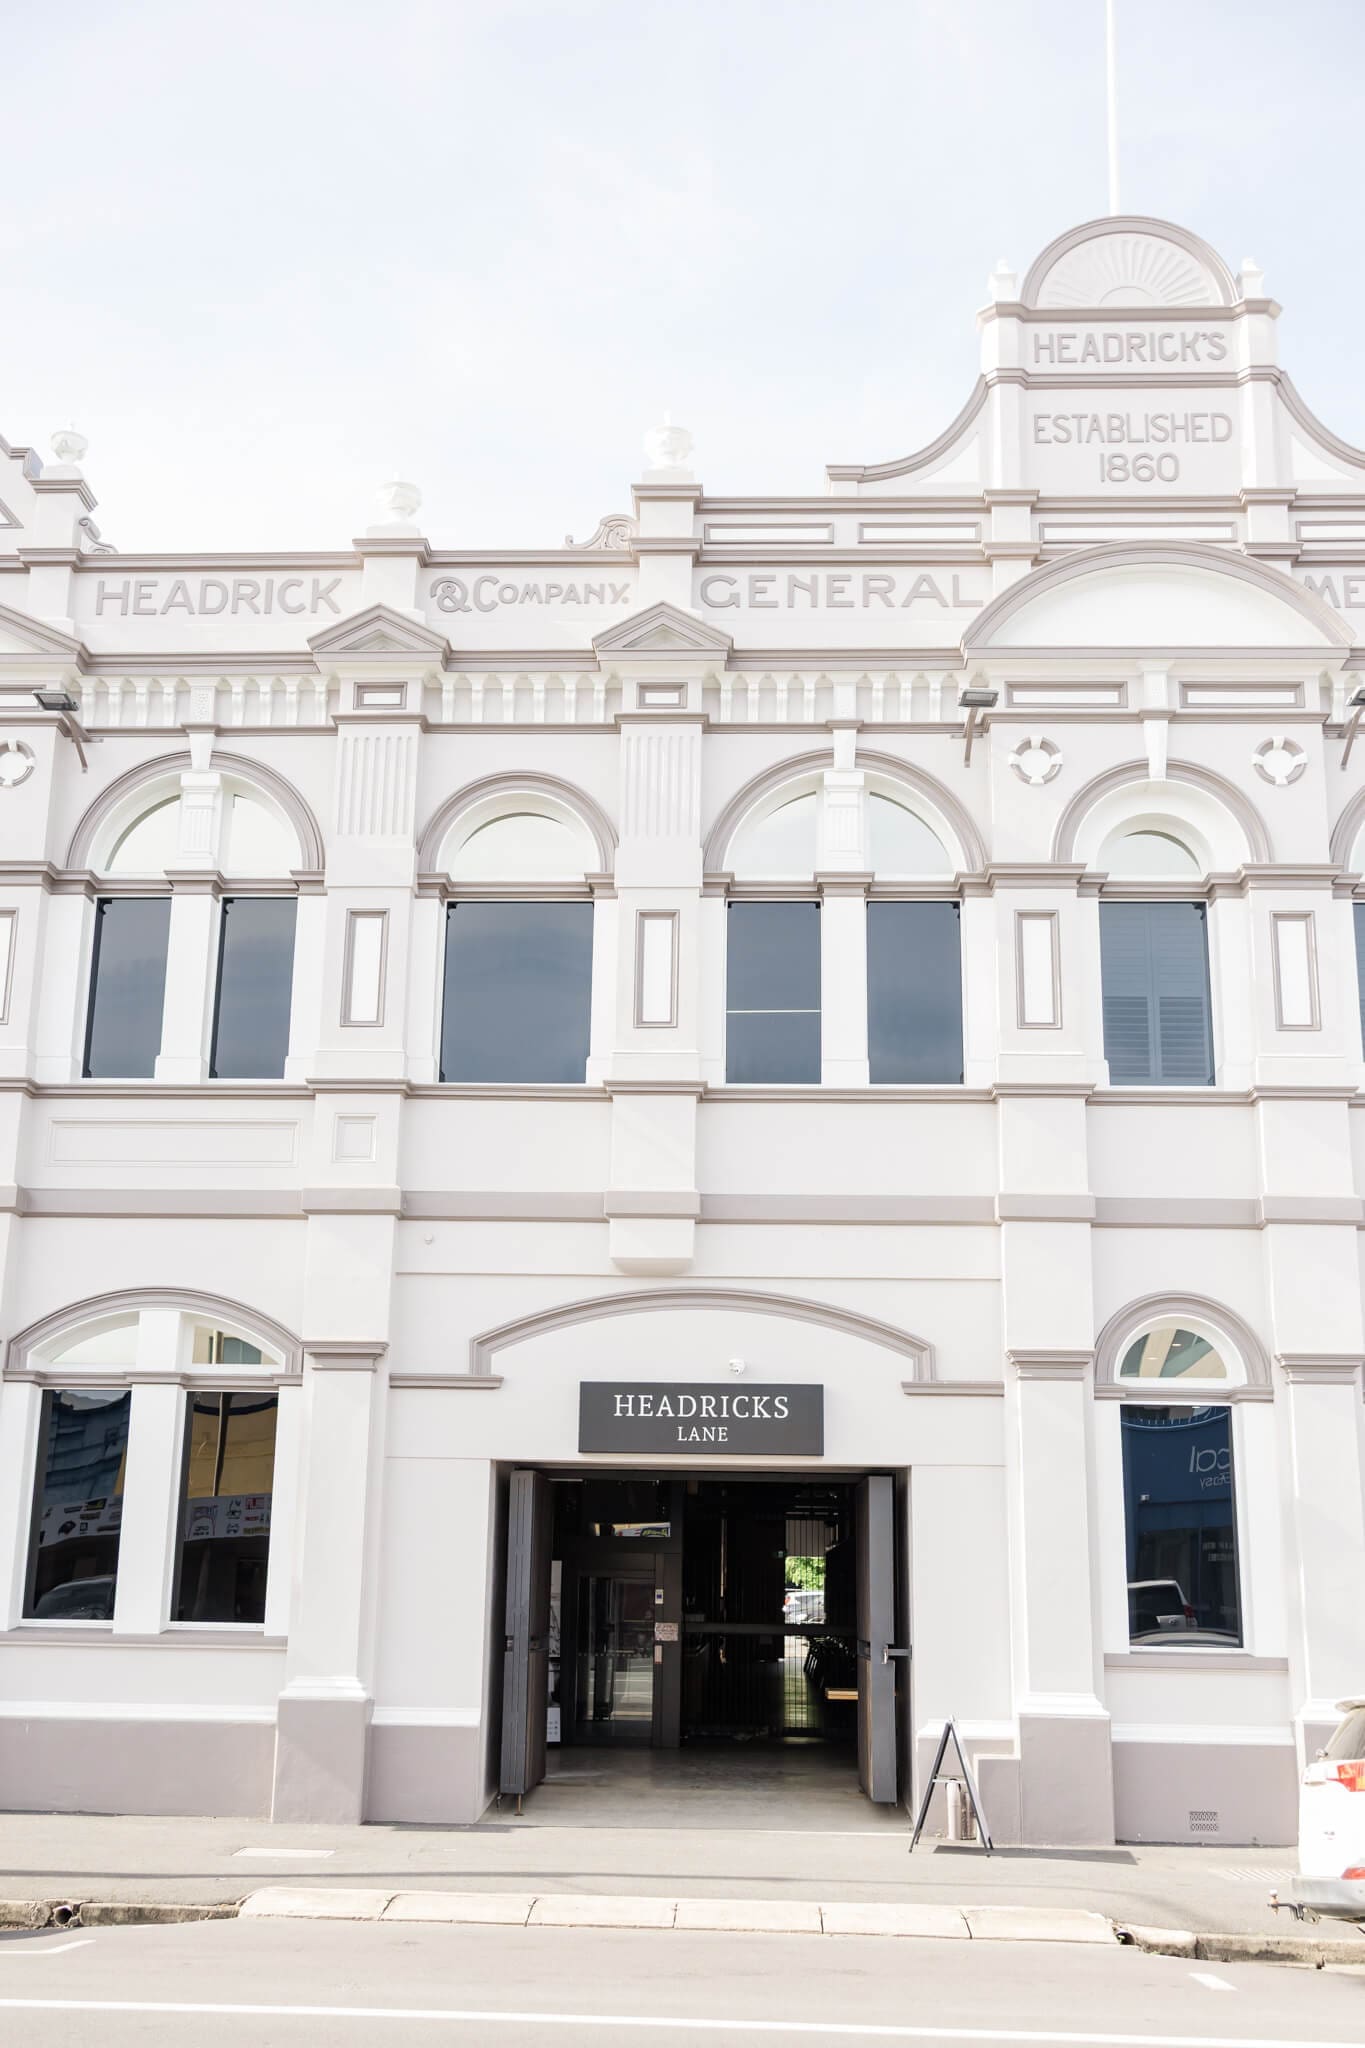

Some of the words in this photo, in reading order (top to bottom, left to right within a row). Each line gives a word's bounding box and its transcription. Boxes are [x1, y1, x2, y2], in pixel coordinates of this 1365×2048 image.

[1033, 331, 1228, 364] HEADRICK'S
[1033, 412, 1233, 444] ESTABLISHED
[1099, 452, 1180, 483] 1860
[95, 578, 343, 616] HEADRICK
[699, 574, 985, 608] GENERAL
[613, 1394, 790, 1419] HEADRICKS
[676, 1426, 729, 1443] LANE
